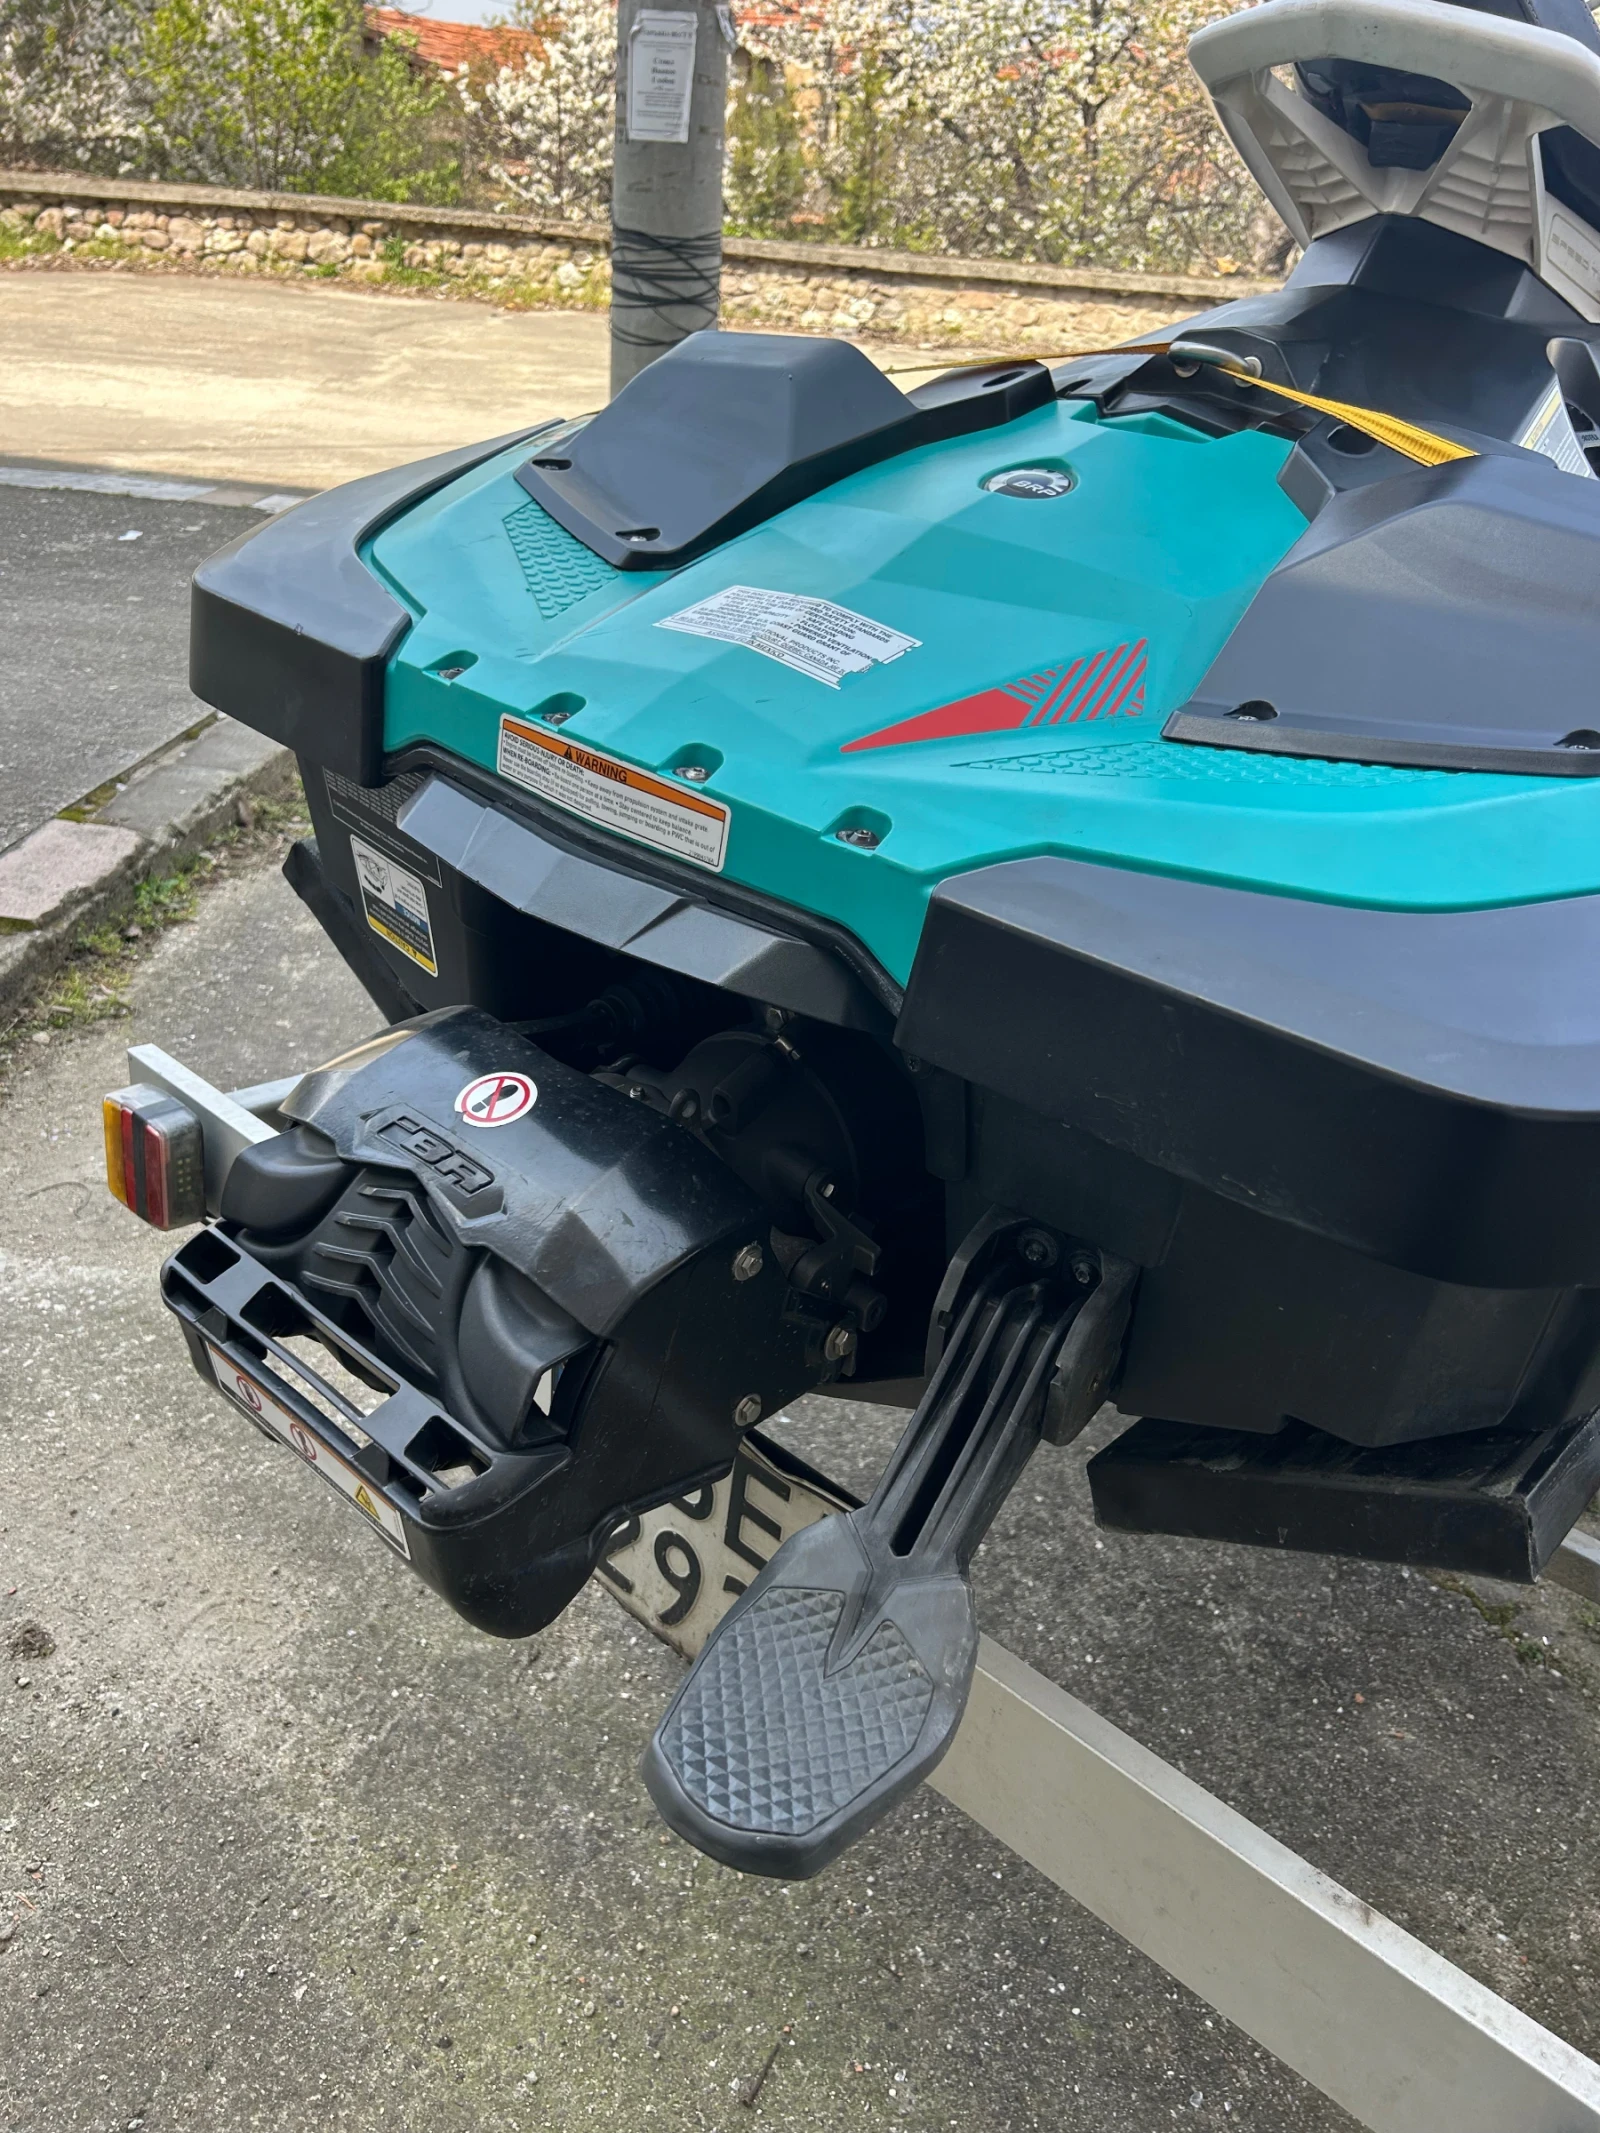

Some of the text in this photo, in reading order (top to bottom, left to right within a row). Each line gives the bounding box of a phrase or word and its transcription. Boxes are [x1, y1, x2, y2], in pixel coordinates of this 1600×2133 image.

[1012, 480, 1057, 496] BRP
[798, 619, 838, 638] FLOTATION
[805, 616, 856, 640] SAFE LOADING
[821, 612, 850, 624] SAFETY
[847, 623, 892, 643] STANDARDS
[830, 610, 860, 623] COMPLY
[858, 622, 880, 632] WITH
[877, 630, 894, 638] THE
[753, 642, 785, 658] MEXICO
[786, 639, 827, 658] PRODUCTS
[824, 656, 842, 665] INC.
[791, 628, 817, 641] GUARD
[814, 639, 841, 652] GRANT
[792, 623, 873, 660] POWERED VENTILATION
[802, 653, 829, 666] CANADA
[504, 732, 584, 776] AVOID SERIOUS INJURY OR DEATH:
[576, 750, 627, 784] WARNING
[502, 746, 516, 759] WHEN
[516, 752, 551, 776] RE-BOARDING:
[618, 801, 629, 811] Stay
[630, 805, 652, 820] centered
[658, 817, 670, 828] keep
[671, 822, 692, 836] balance.
[612, 790, 623, 800] from
[624, 794, 649, 811] propulsion
[650, 805, 667, 818] system
[668, 811, 677, 820] and
[678, 815, 693, 827] intake
[618, 809, 638, 824] jumping
[644, 820, 666, 835] boarding
[671, 830, 684, 841] PWC
[684, 835, 694, 845] that
[700, 842, 709, 851] out
[709, 845, 715, 853] of
[596, 1516, 749, 1626] 29
